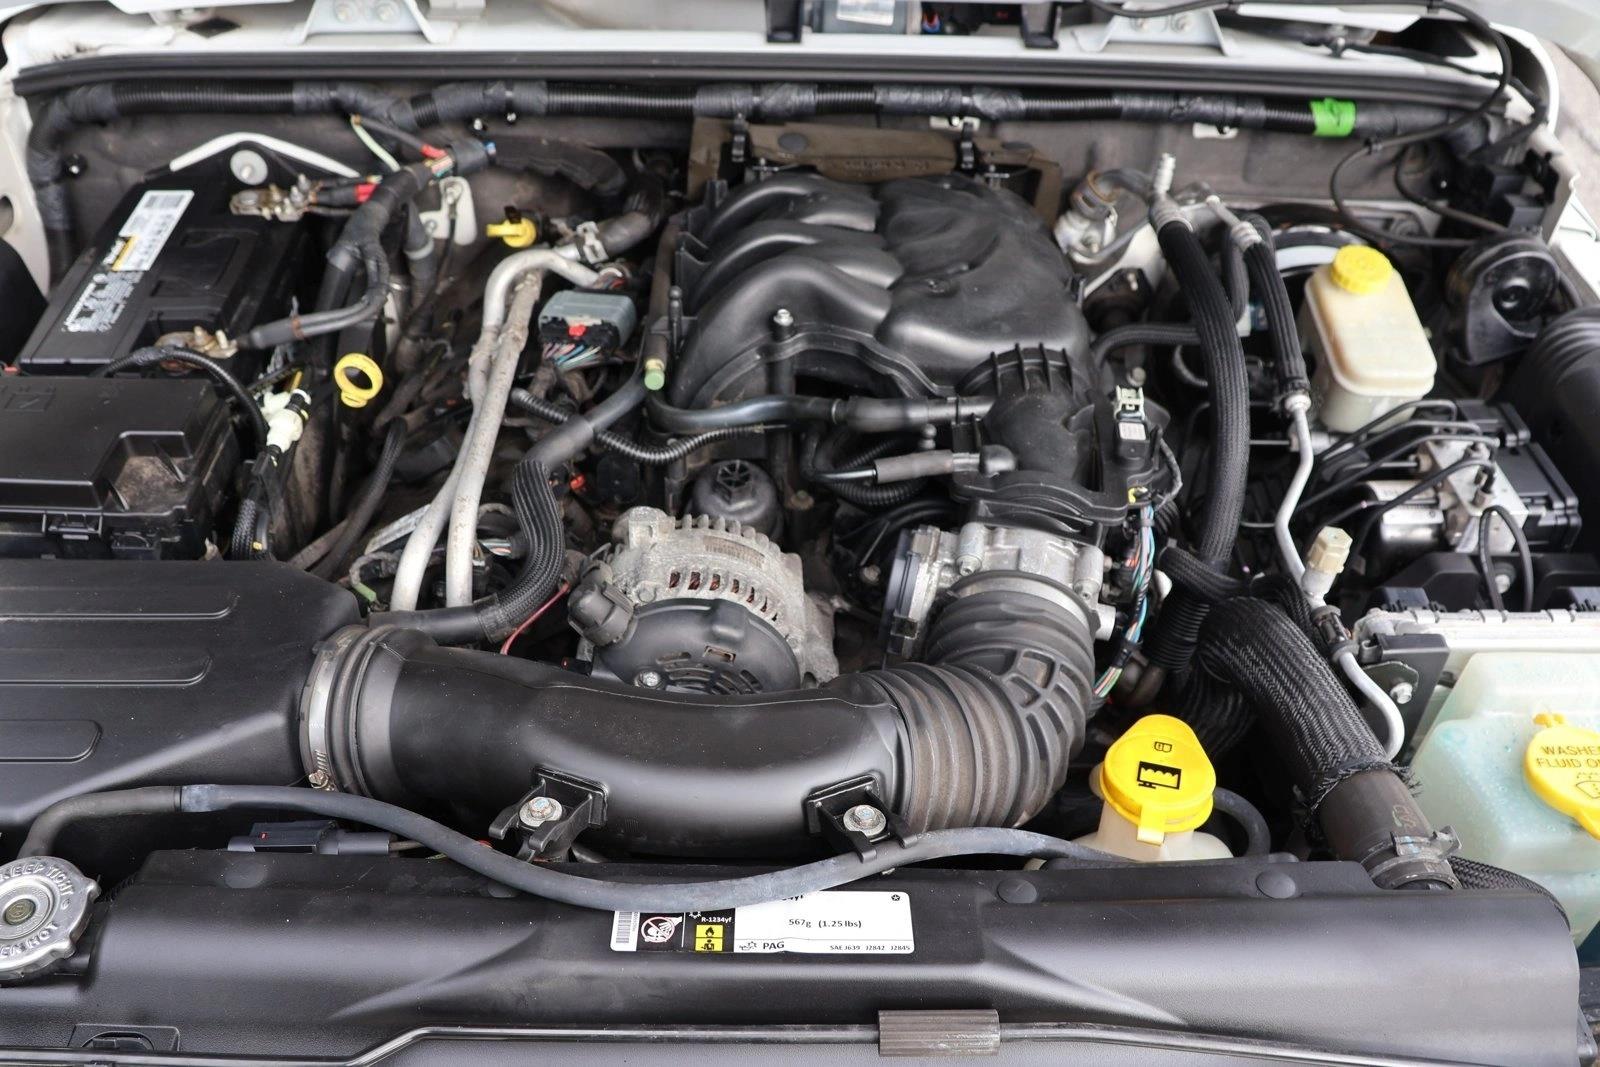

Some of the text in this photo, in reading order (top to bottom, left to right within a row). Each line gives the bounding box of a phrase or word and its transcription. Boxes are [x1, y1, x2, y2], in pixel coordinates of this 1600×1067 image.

[1541, 745, 1600, 755] WASHE
[1536, 758, 1581, 767] FLUID
[46, 866, 75, 896] TIGHT
[788, 918, 862, 928] 567g (1.25 lbs)
[0, 921, 58, 958] EN HOT
[762, 941, 785, 950] PAG
